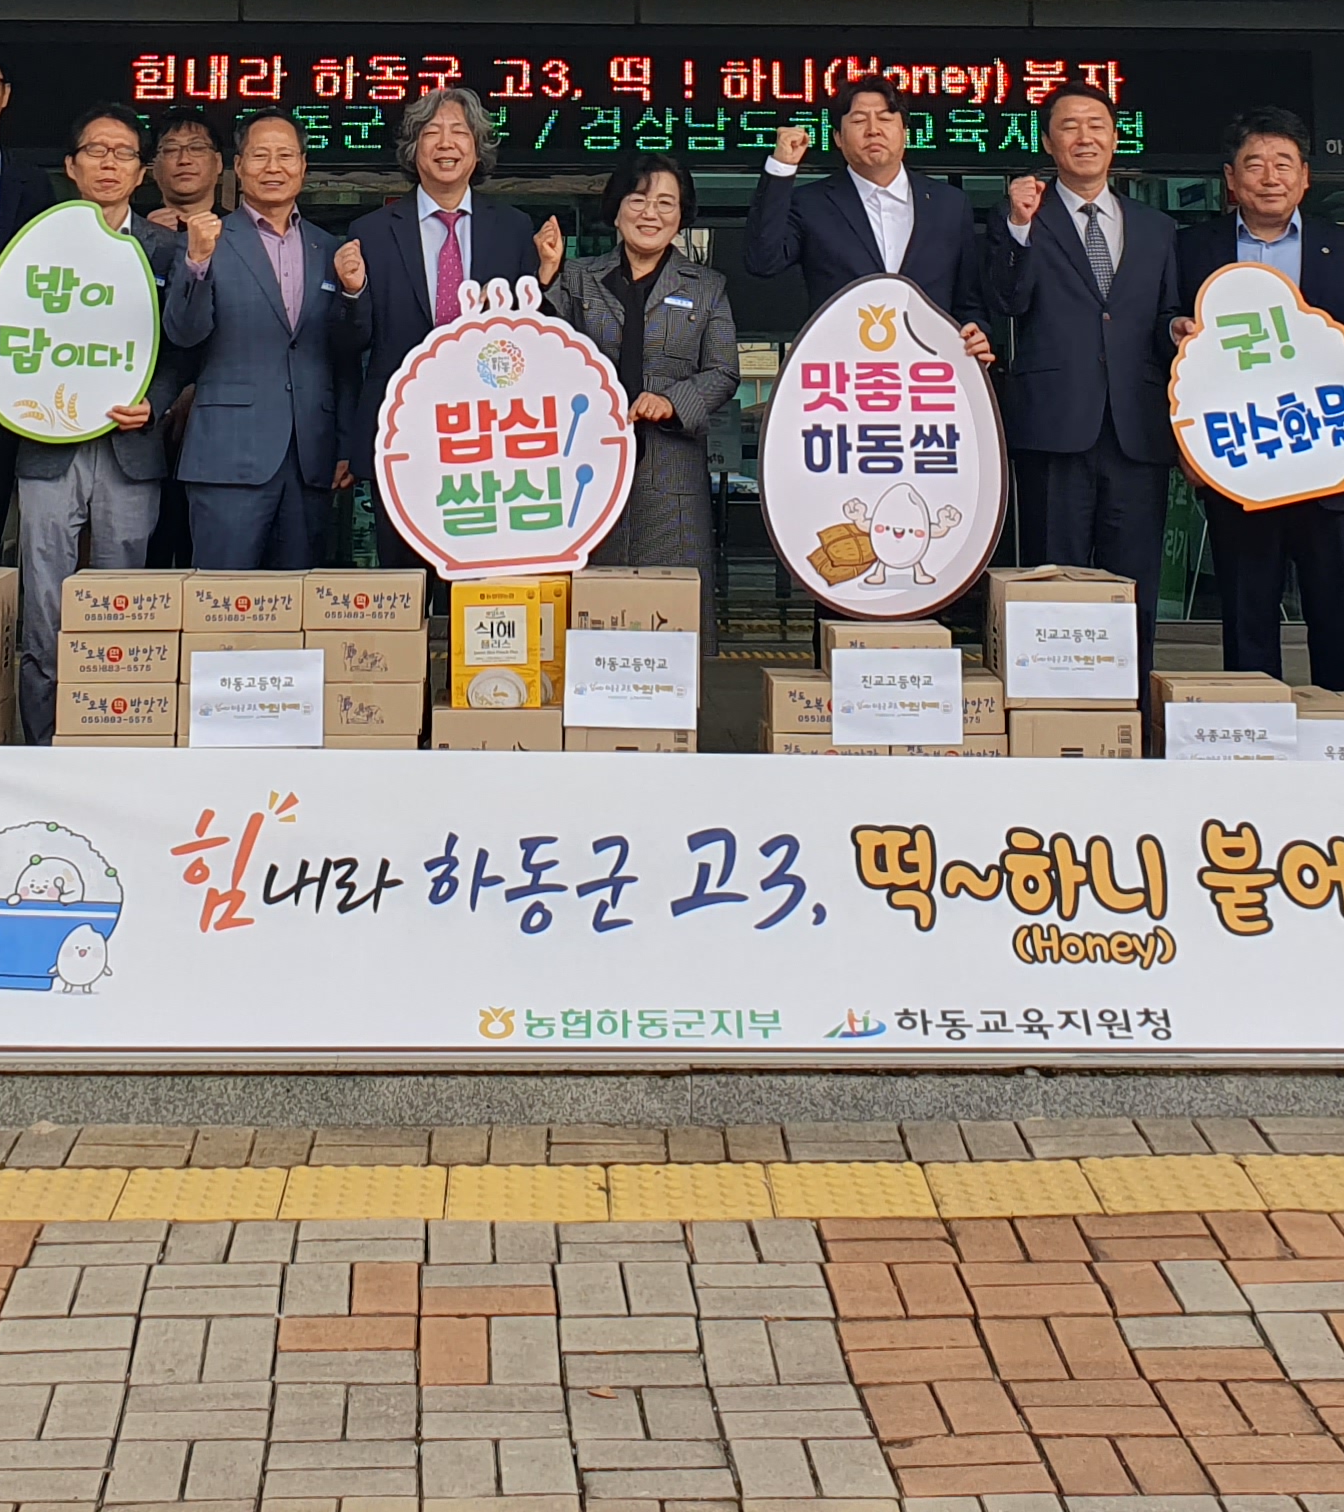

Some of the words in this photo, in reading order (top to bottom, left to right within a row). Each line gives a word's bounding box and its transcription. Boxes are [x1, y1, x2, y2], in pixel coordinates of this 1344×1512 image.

[133, 55, 287, 101] 힘내라
[610, 57, 651, 102] 떡
[26, 264, 114, 314] 밥이
[801, 361, 957, 413] 맛좋은
[435, 395, 559, 464] 밥심
[801, 423, 960, 475] 하동쌀
[435, 466, 564, 537] 쌀심
[1035, 628, 1109, 643] 진교고등학교
[219, 676, 295, 692] 하동고등학교
[594, 656, 669, 672] 하동고등학교
[860, 675, 934, 689] 진교고등학교
[170, 808, 403, 933] 힘내라
[423, 832, 639, 934] 하동군
[670, 827, 827, 930] 고3,
[1012, 924, 1177, 970] (Honey)
[523, 1007, 783, 1040] 농협하동군지부
[893, 1006, 1173, 1041] 하동교육지원청
